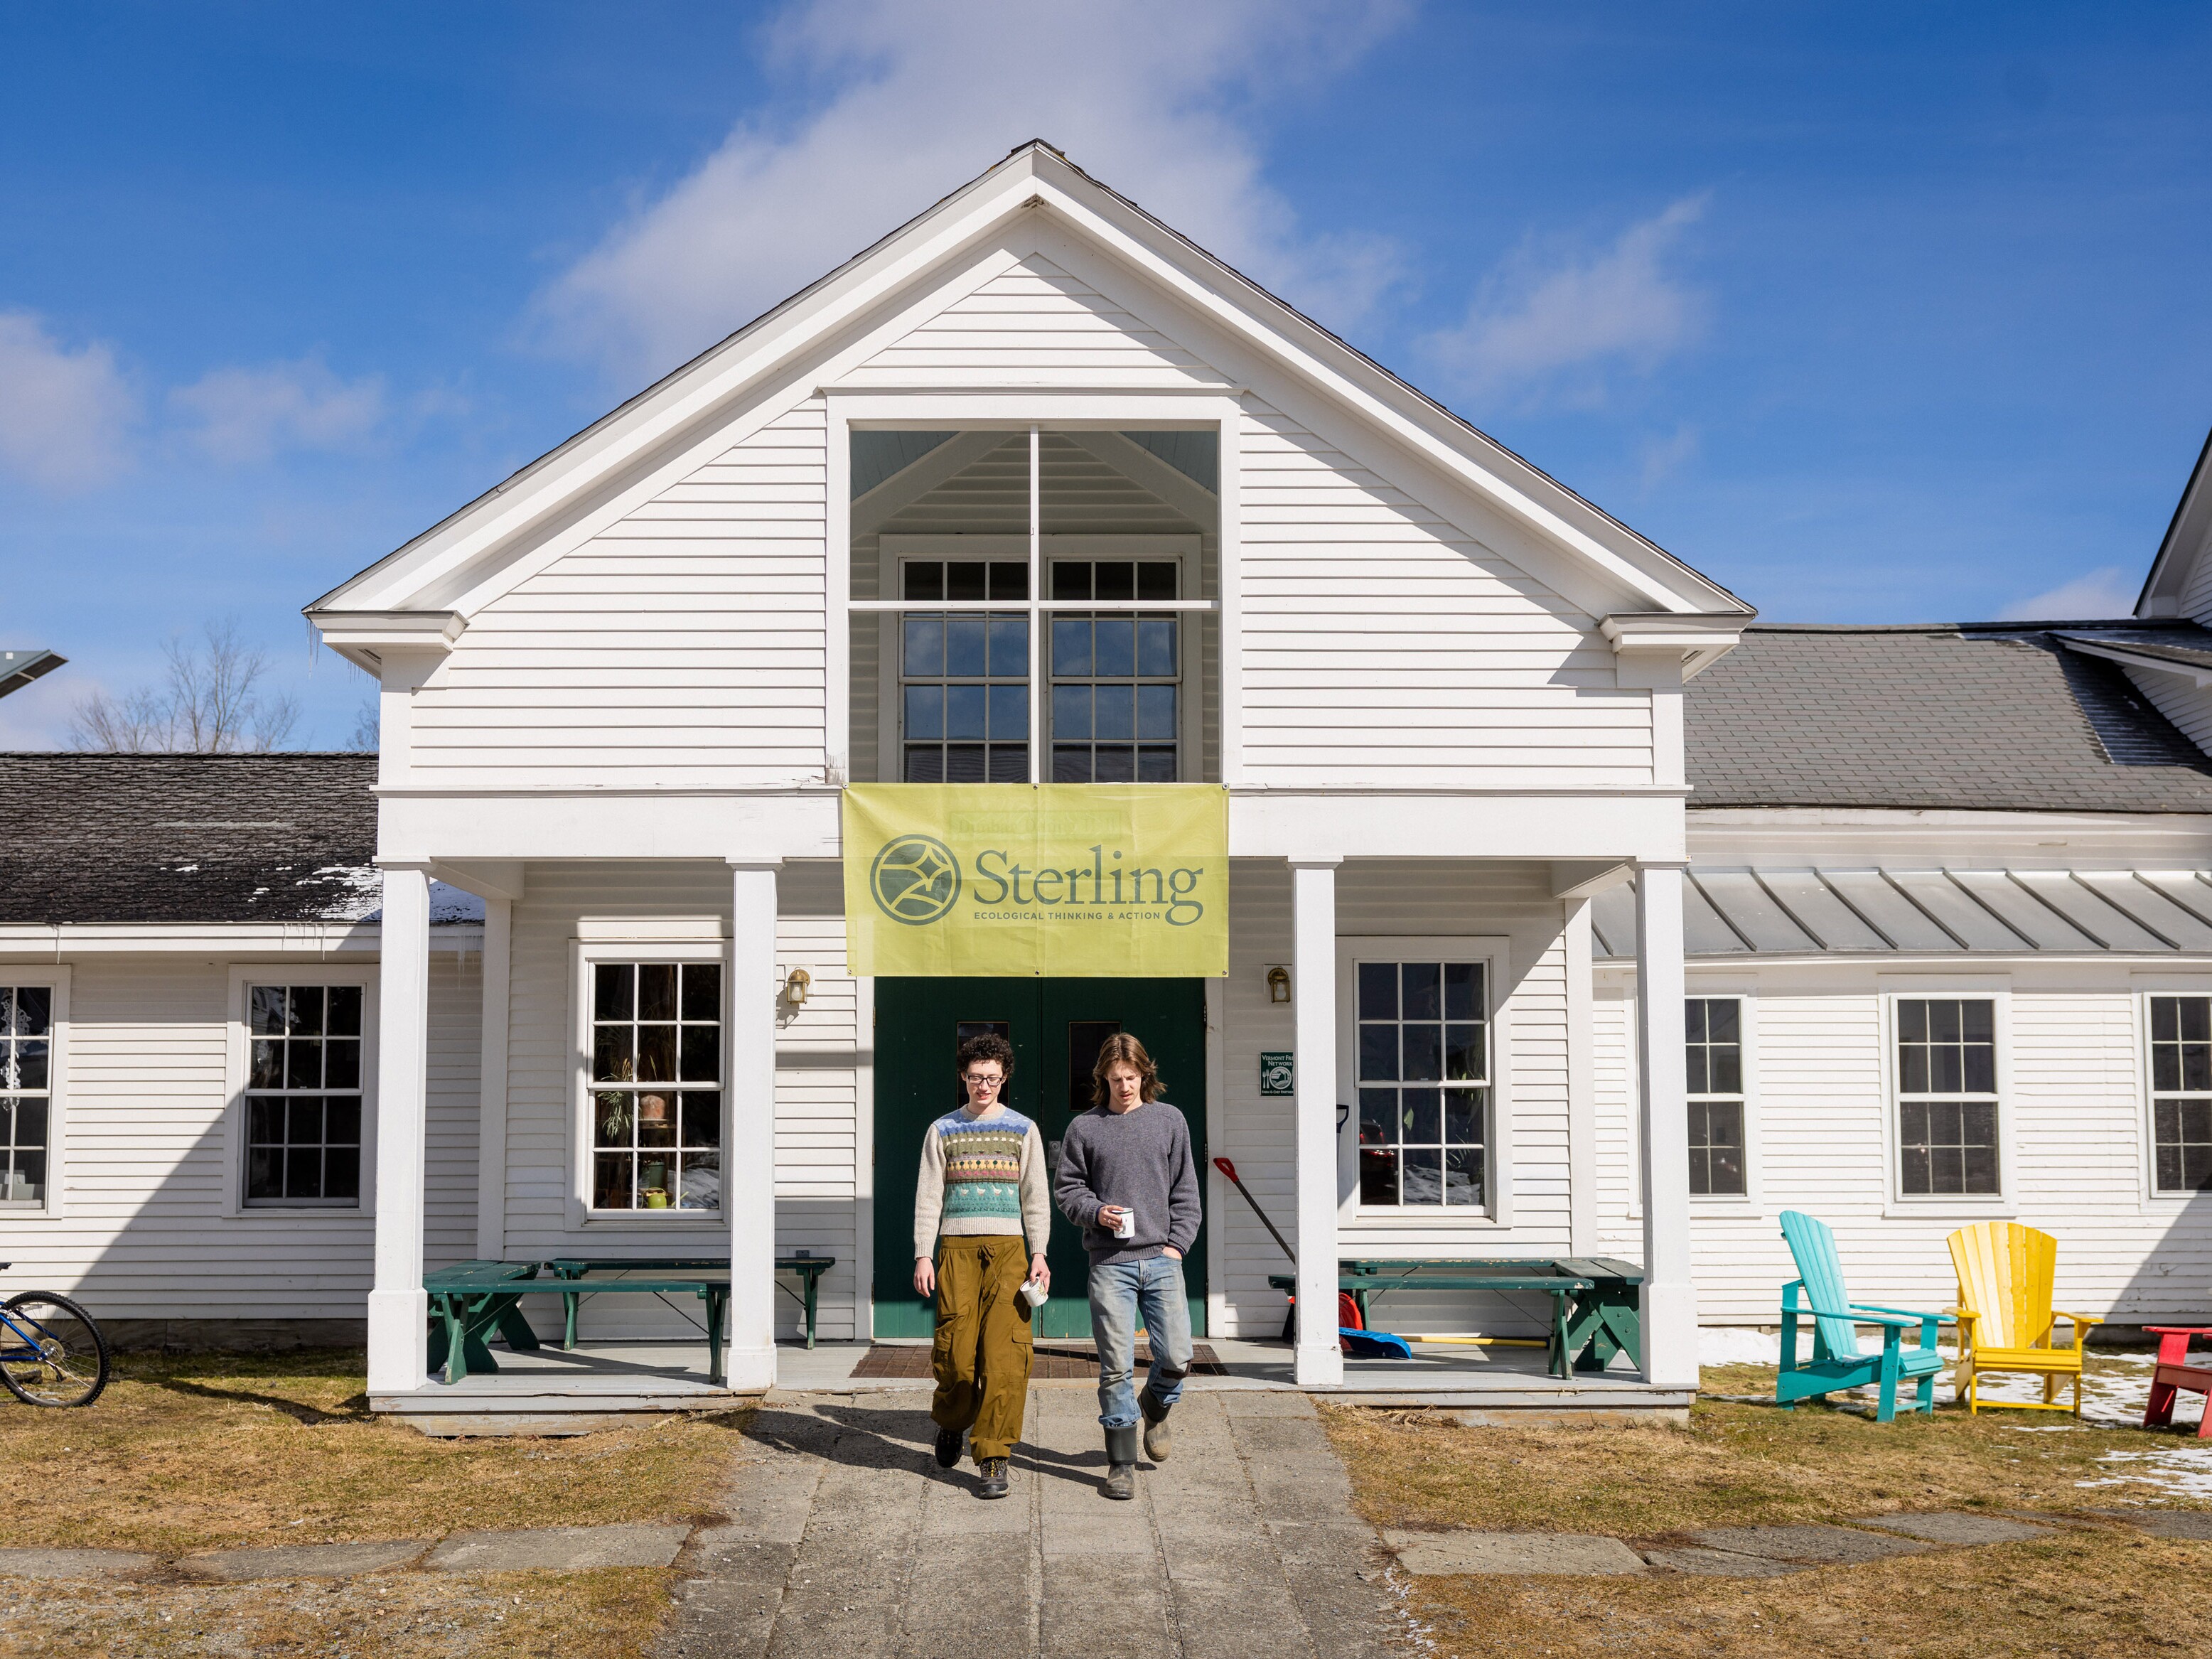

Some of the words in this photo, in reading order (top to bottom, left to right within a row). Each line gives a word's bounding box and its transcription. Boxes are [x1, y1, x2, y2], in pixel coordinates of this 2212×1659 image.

[975, 844, 1203, 925] Sterling
[974, 911, 1044, 920] ECOLOGICAL
[1048, 911, 1102, 920] THINKING
[1118, 911, 1160, 920] ACTION
